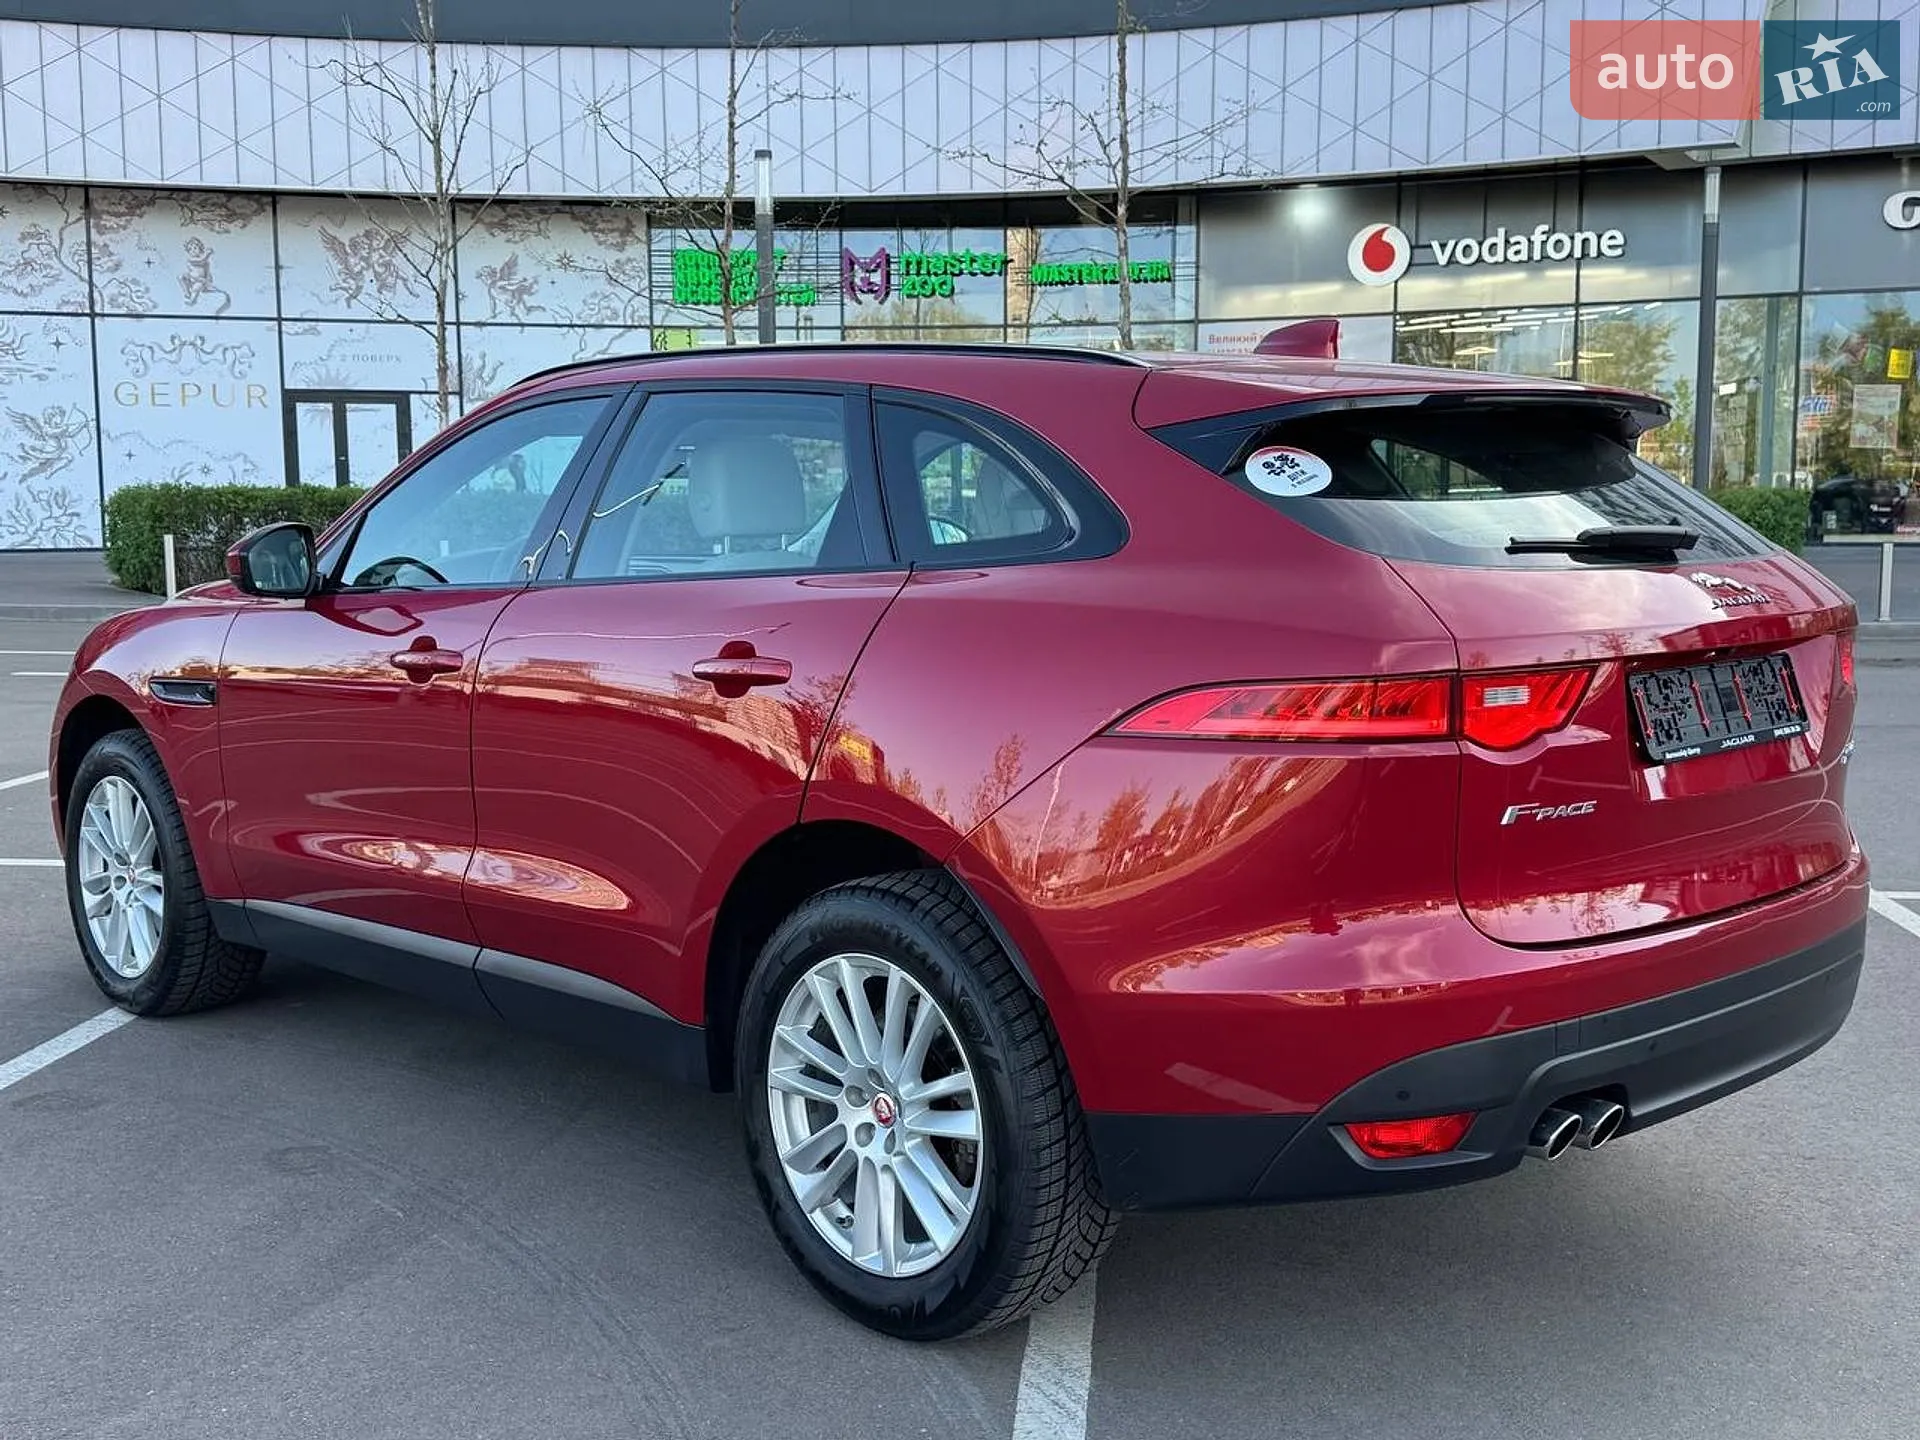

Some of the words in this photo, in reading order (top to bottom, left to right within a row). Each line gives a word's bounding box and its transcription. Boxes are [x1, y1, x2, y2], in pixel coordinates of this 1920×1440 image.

[1430, 224, 1625, 265] vodafone
[900, 249, 1008, 275] master
[114, 381, 268, 409] GEPUR
[1720, 734, 1756, 748] JAGUAR
